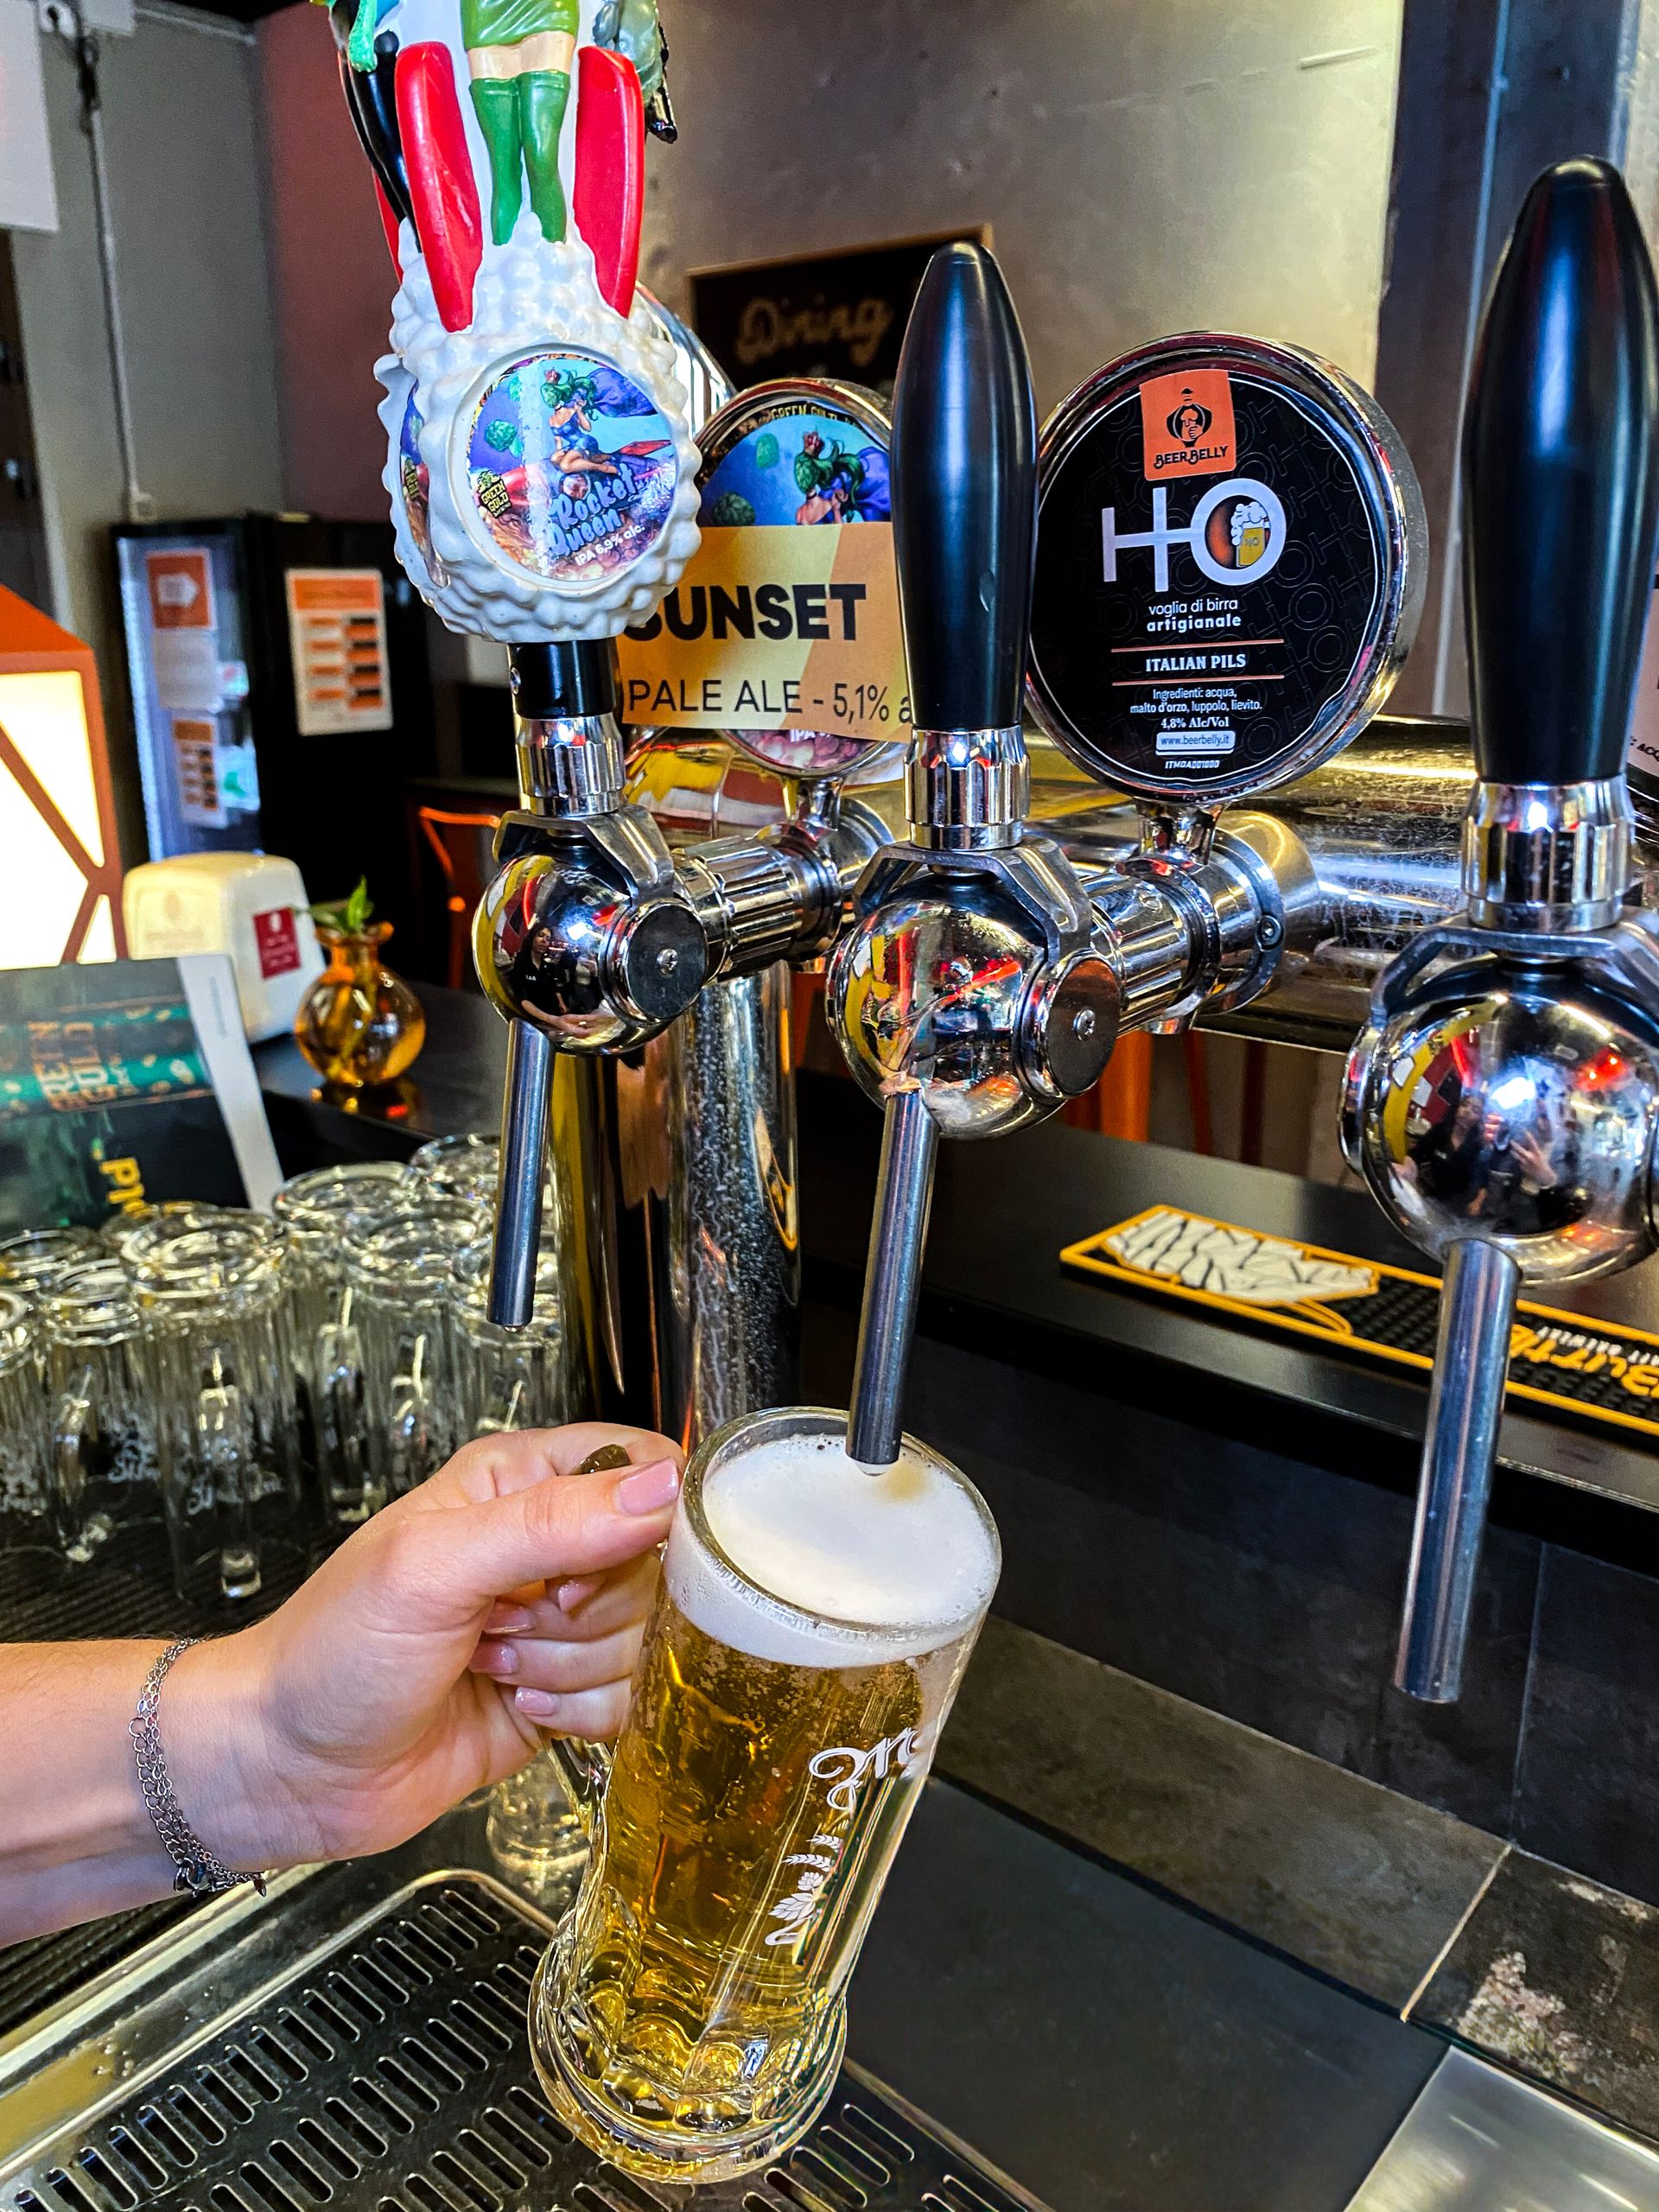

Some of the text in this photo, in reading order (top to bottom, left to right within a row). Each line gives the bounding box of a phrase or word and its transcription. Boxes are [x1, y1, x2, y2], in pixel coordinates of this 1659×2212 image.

[549, 463, 637, 530] Rocket
[549, 509, 622, 556] Queen
[575, 550, 597, 566] IPA
[1148, 598, 1238, 617] voglia di birra
[1147, 613, 1242, 632] artigianale
[1146, 654, 1246, 671] ITALIAN PILS
[628, 679, 722, 712] PALE
[734, 680, 804, 714] ALE
[833, 683, 890, 724] 5,1%
[1153, 688, 1237, 701] Ingredienti: acqua,
[1130, 699, 1262, 714] malto d'orzo, luppolo, lievito.
[1160, 716, 1230, 730] 4,8% Alc/Vol
[1160, 735, 1230, 747] www.beerbelly.it
